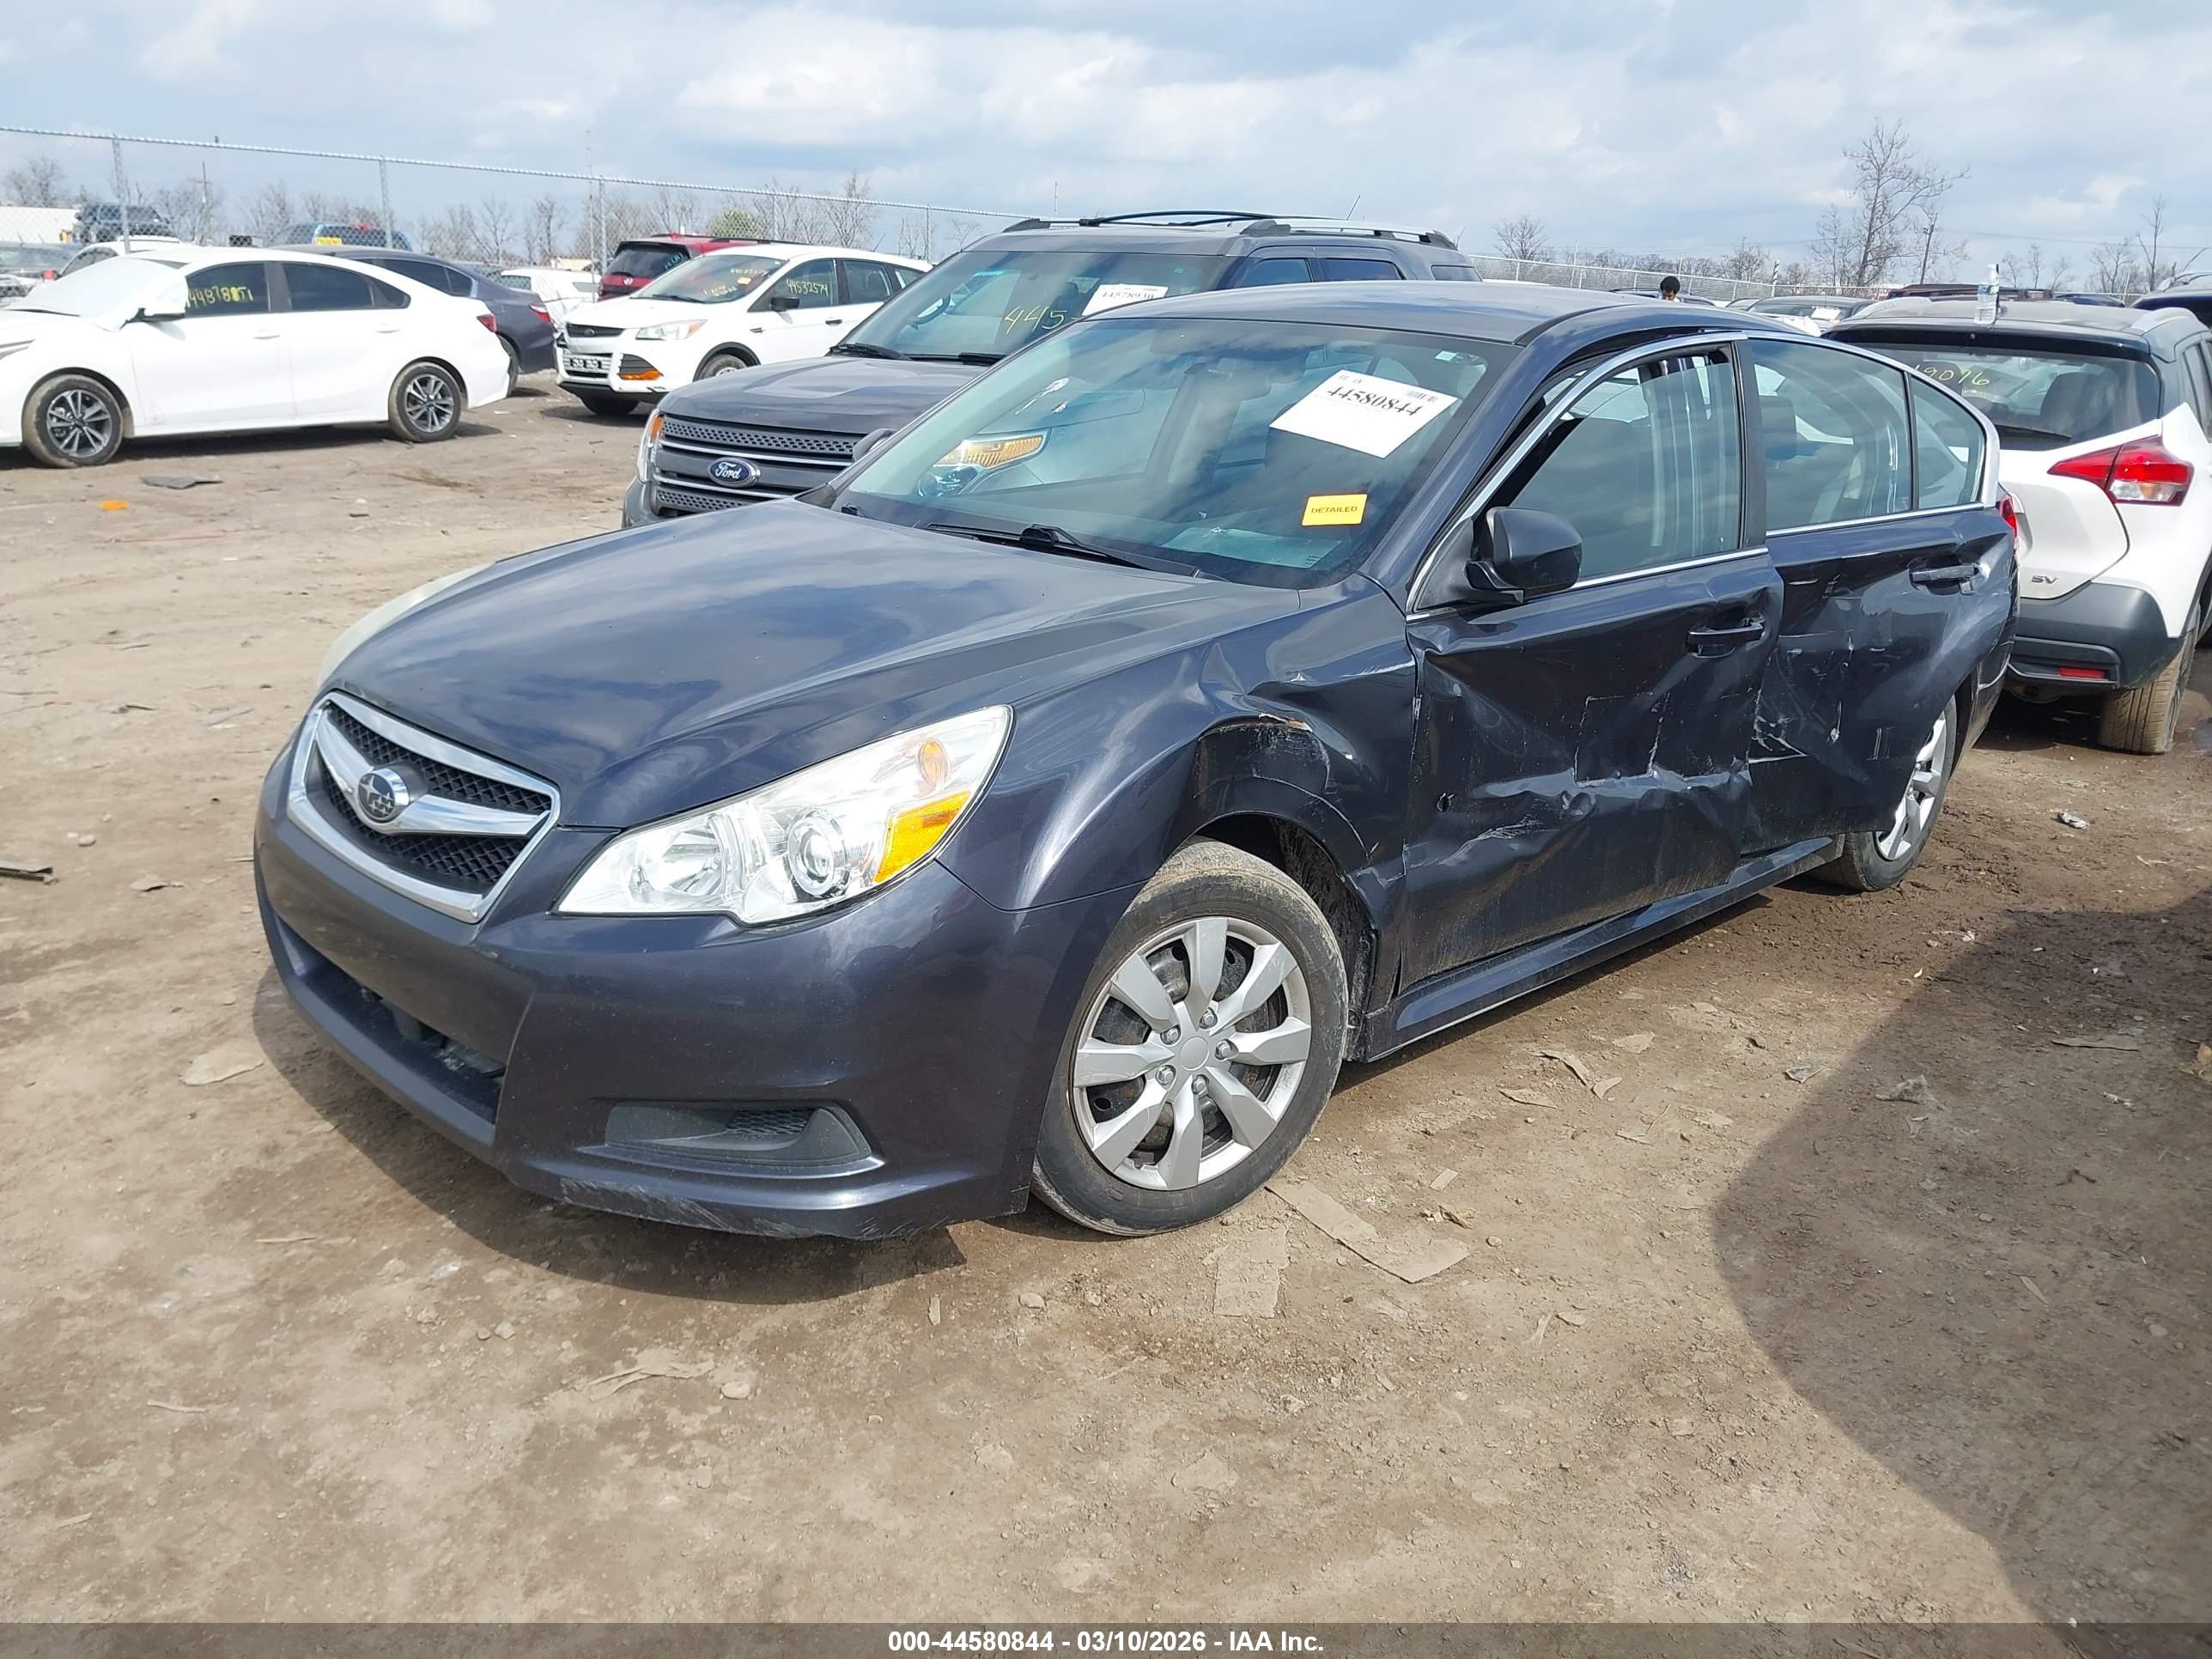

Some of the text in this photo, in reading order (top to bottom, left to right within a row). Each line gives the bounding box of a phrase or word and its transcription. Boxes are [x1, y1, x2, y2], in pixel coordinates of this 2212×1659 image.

[786, 277, 829, 297] 44532574
[1328, 386, 1423, 416] 44580844
[714, 461, 743, 479] Ford
[1310, 506, 1358, 514] DETAILED
[2032, 574, 2060, 585] SV
